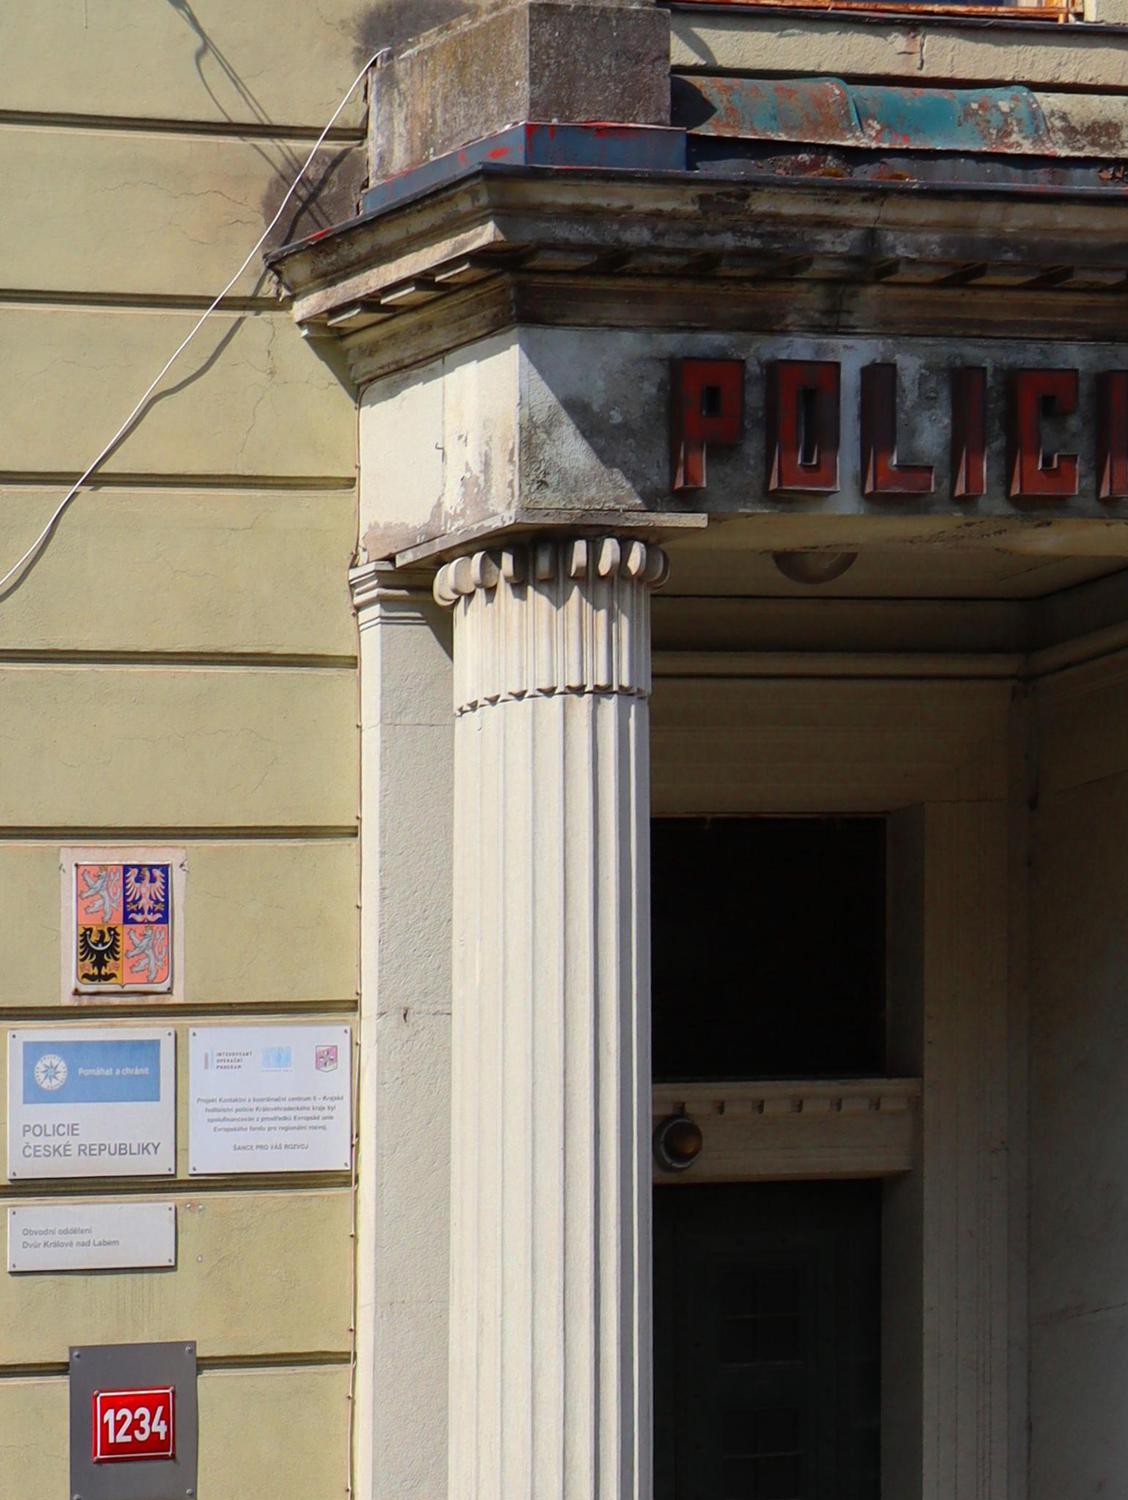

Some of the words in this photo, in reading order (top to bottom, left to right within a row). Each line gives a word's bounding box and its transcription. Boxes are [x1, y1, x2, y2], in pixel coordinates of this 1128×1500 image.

[78, 1067, 113, 1077] Pomáhat
[121, 1067, 150, 1076] chránit
[22, 1123, 80, 1138] POLICIE
[22, 1141, 73, 1158] ČESKÉ
[78, 1142, 161, 1157] REPUBLIKY
[75, 1239, 91, 1247] nad
[93, 1238, 120, 1247] Labem
[103, 1405, 168, 1444] 1234
